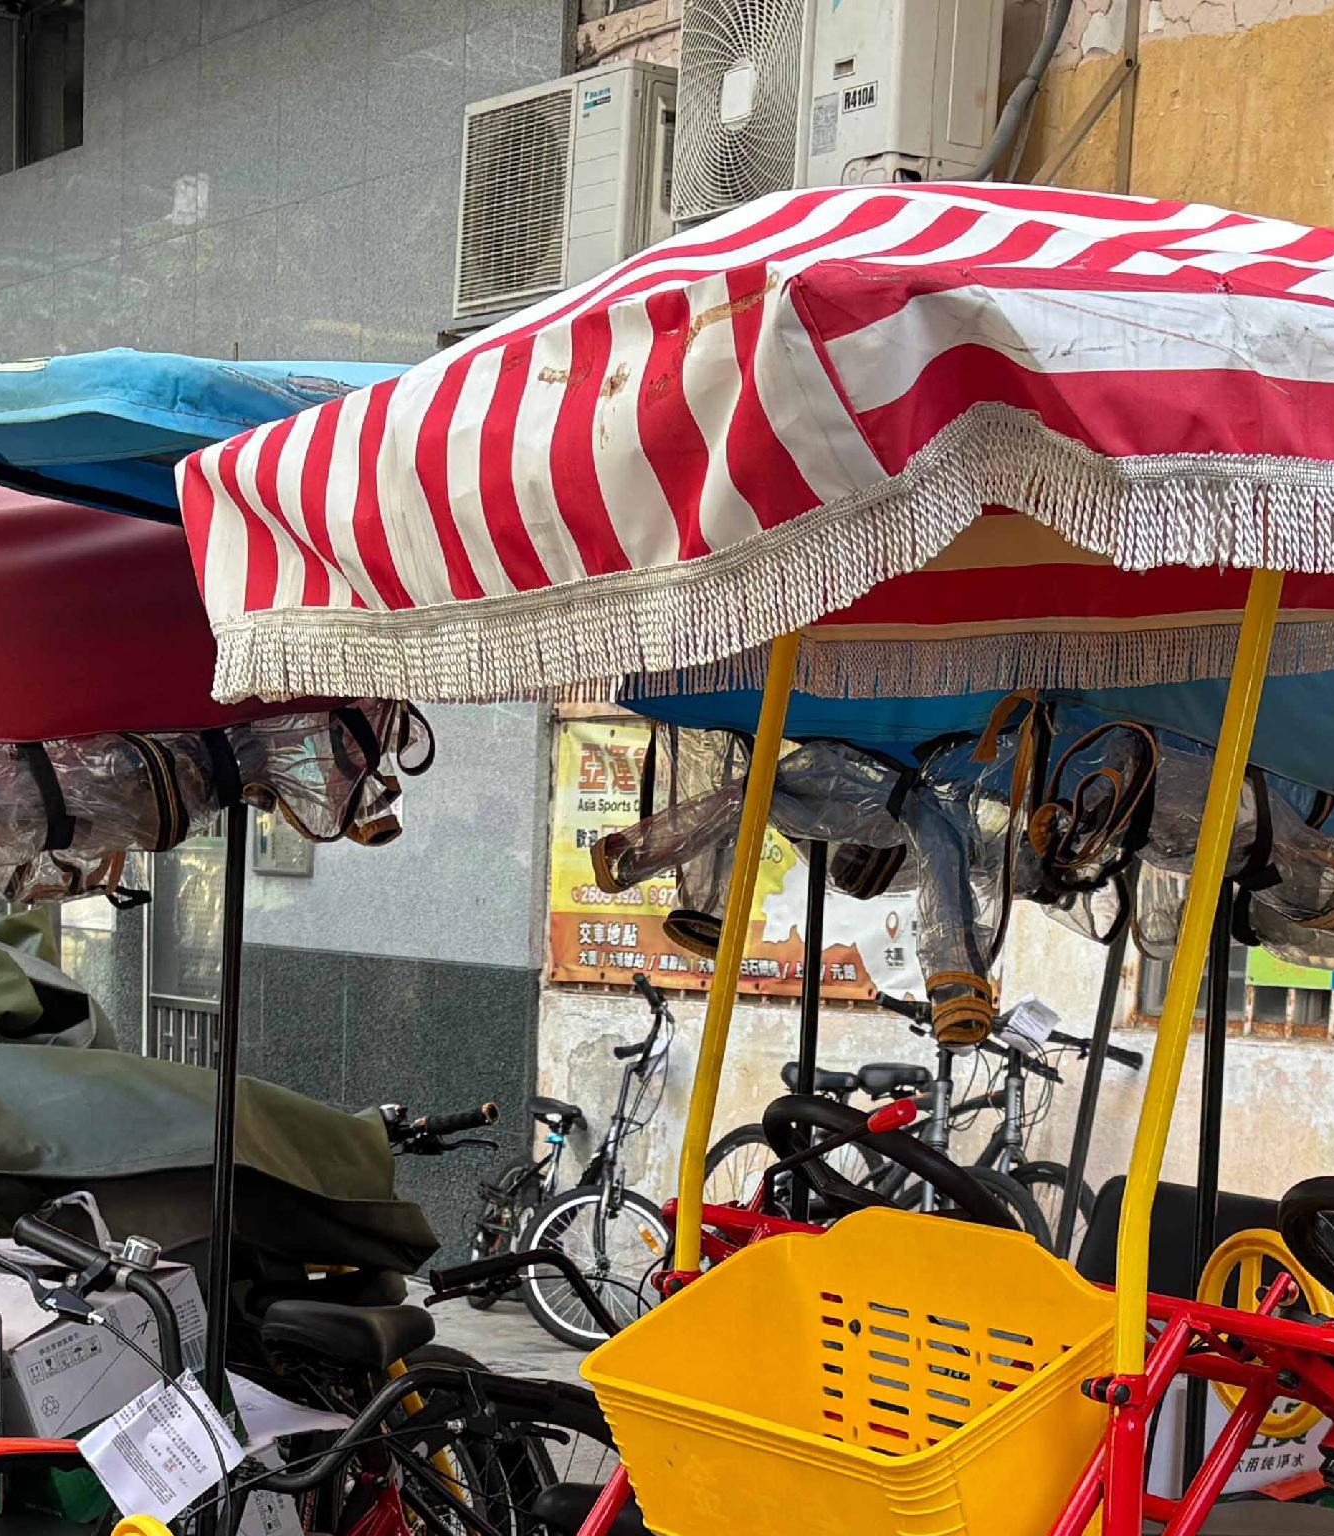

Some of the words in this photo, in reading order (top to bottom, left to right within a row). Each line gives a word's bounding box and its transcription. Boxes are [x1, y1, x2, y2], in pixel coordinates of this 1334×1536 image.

[844, 85, 875, 110] R410A
[578, 799, 596, 812] Asia
[598, 799, 631, 815] Sports
